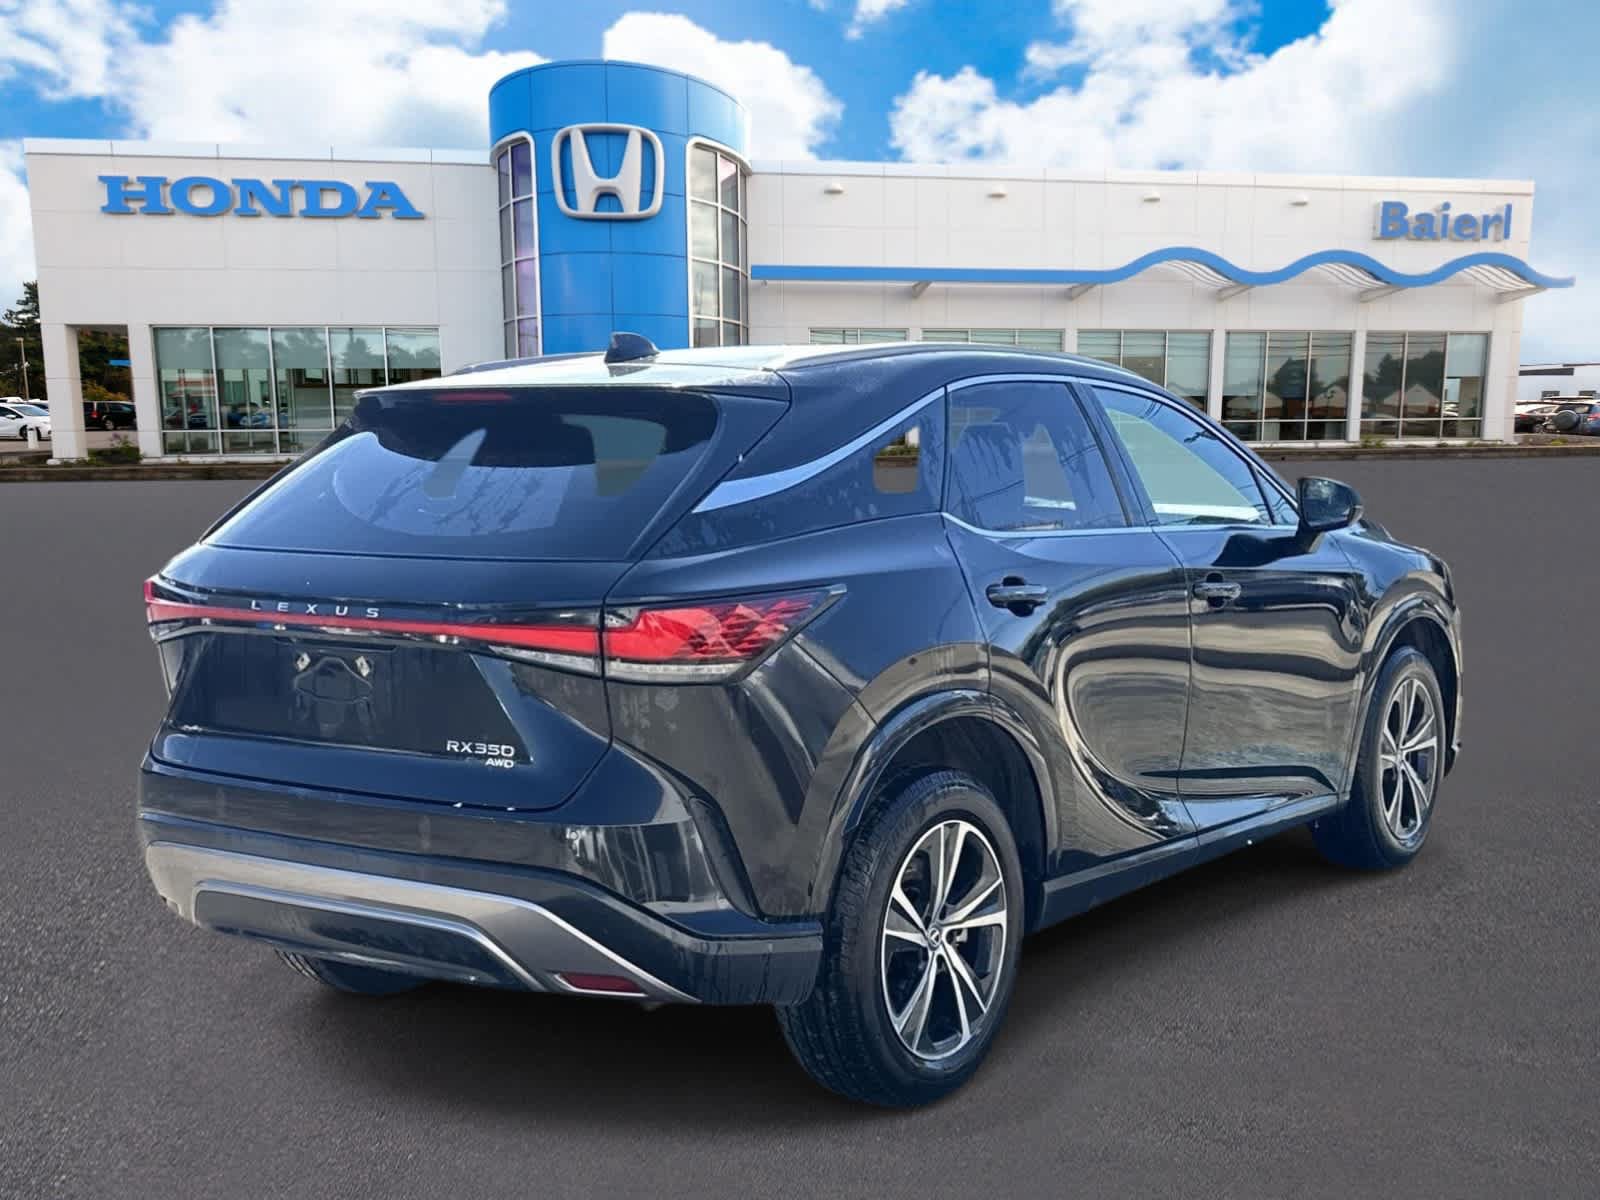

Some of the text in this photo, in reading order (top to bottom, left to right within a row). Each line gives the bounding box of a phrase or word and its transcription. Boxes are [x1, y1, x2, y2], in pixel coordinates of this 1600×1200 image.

[97, 175, 425, 219] HONDA
[1379, 200, 1513, 240] Baierl
[250, 599, 380, 618] LEXUS
[485, 757, 515, 769] AWD
